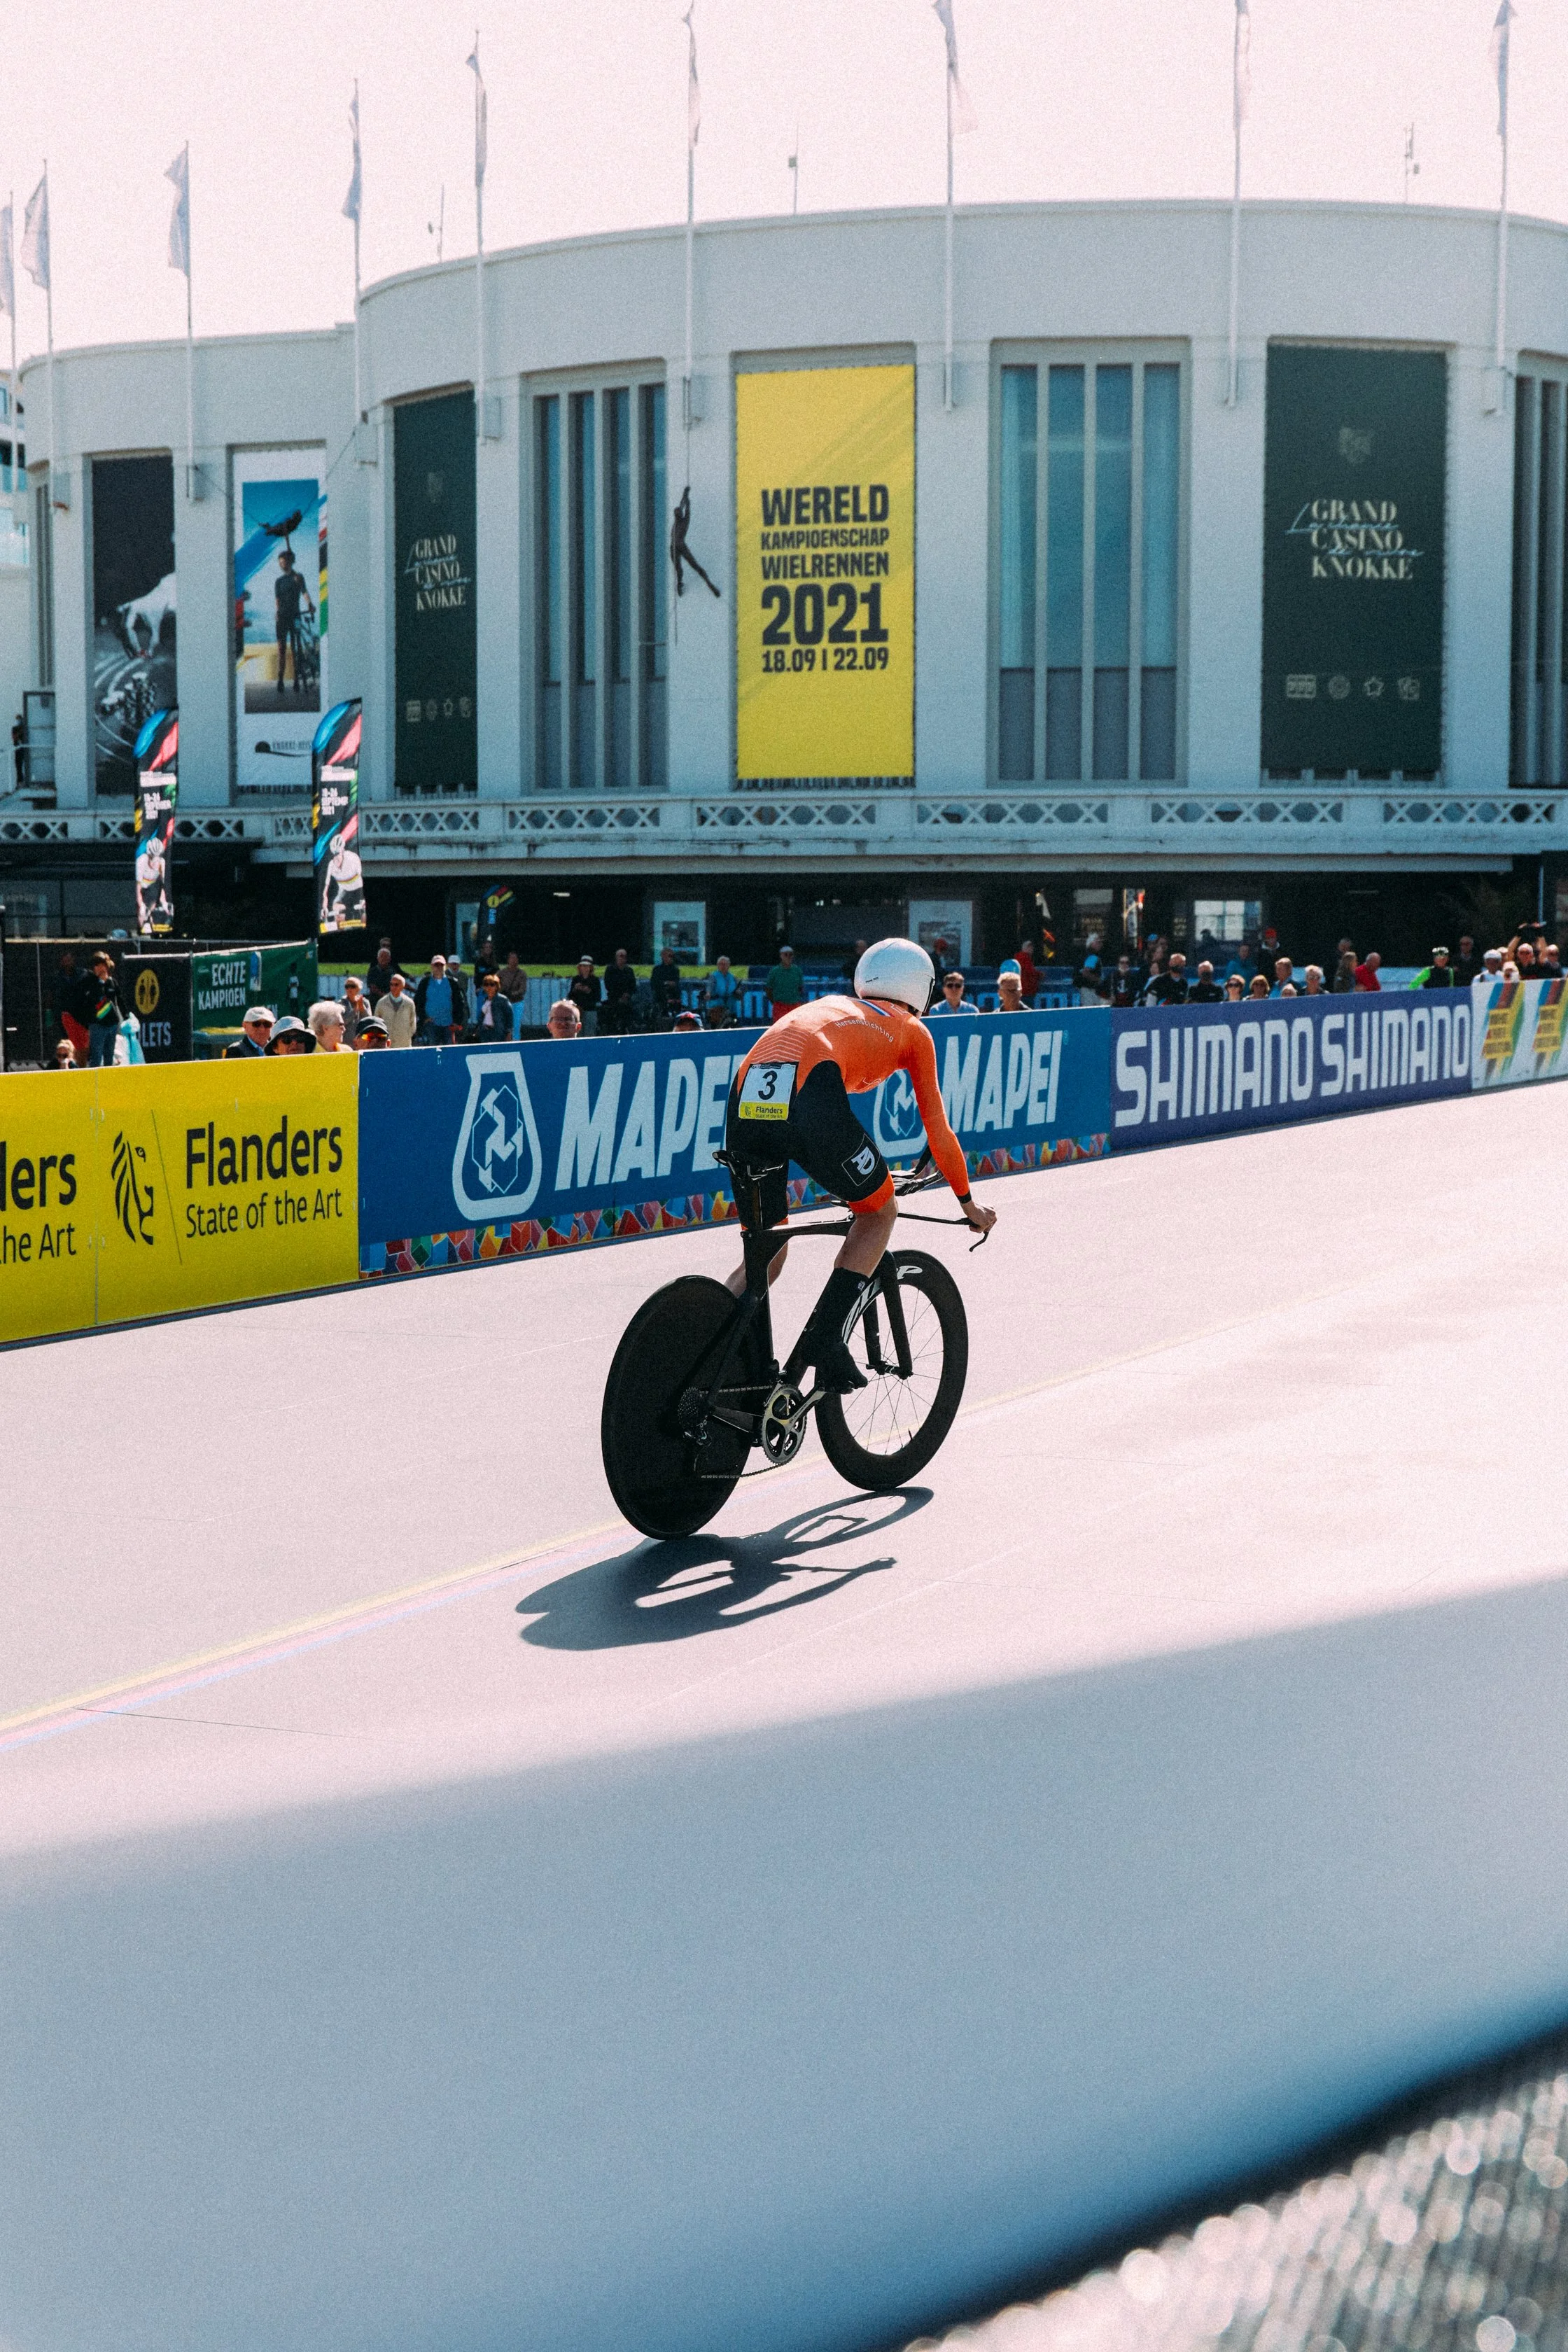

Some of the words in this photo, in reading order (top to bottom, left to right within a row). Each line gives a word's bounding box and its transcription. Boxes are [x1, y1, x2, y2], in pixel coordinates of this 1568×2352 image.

[761, 484, 890, 527] WERELD
[1312, 500, 1398, 522] GRAND
[415, 534, 456, 559] GRAND
[761, 528, 890, 550] KAMPIOENSCHAP
[1311, 528, 1404, 551] CASINO
[415, 560, 461, 585] CASINO
[761, 552, 890, 580] WIELRENNEN
[1312, 556, 1414, 580] KNOKKE
[416, 586, 466, 611] KNOKKE
[761, 582, 889, 645] 2021
[762, 649, 816, 672] 18.09
[833, 647, 889, 670] 22.09
[211, 960, 246, 986] ECHTE
[198, 988, 246, 1010] KAMPIOEN
[834, 1019, 894, 1043] Hersenstichting
[1320, 1004, 1470, 1098] SHIMANO
[757, 1070, 778, 1100] 3
[942, 1030, 1063, 1133] MAPEI
[1114, 1017, 1314, 1128] SHIMANO
[186, 1115, 343, 1189] Flanders
[186, 1203, 239, 1239] State
[246, 1192, 268, 1230] of
[274, 1190, 307, 1226] the
[312, 1188, 343, 1221] Art
[0, 1225, 31, 1264] he
[38, 1223, 77, 1259] Art
